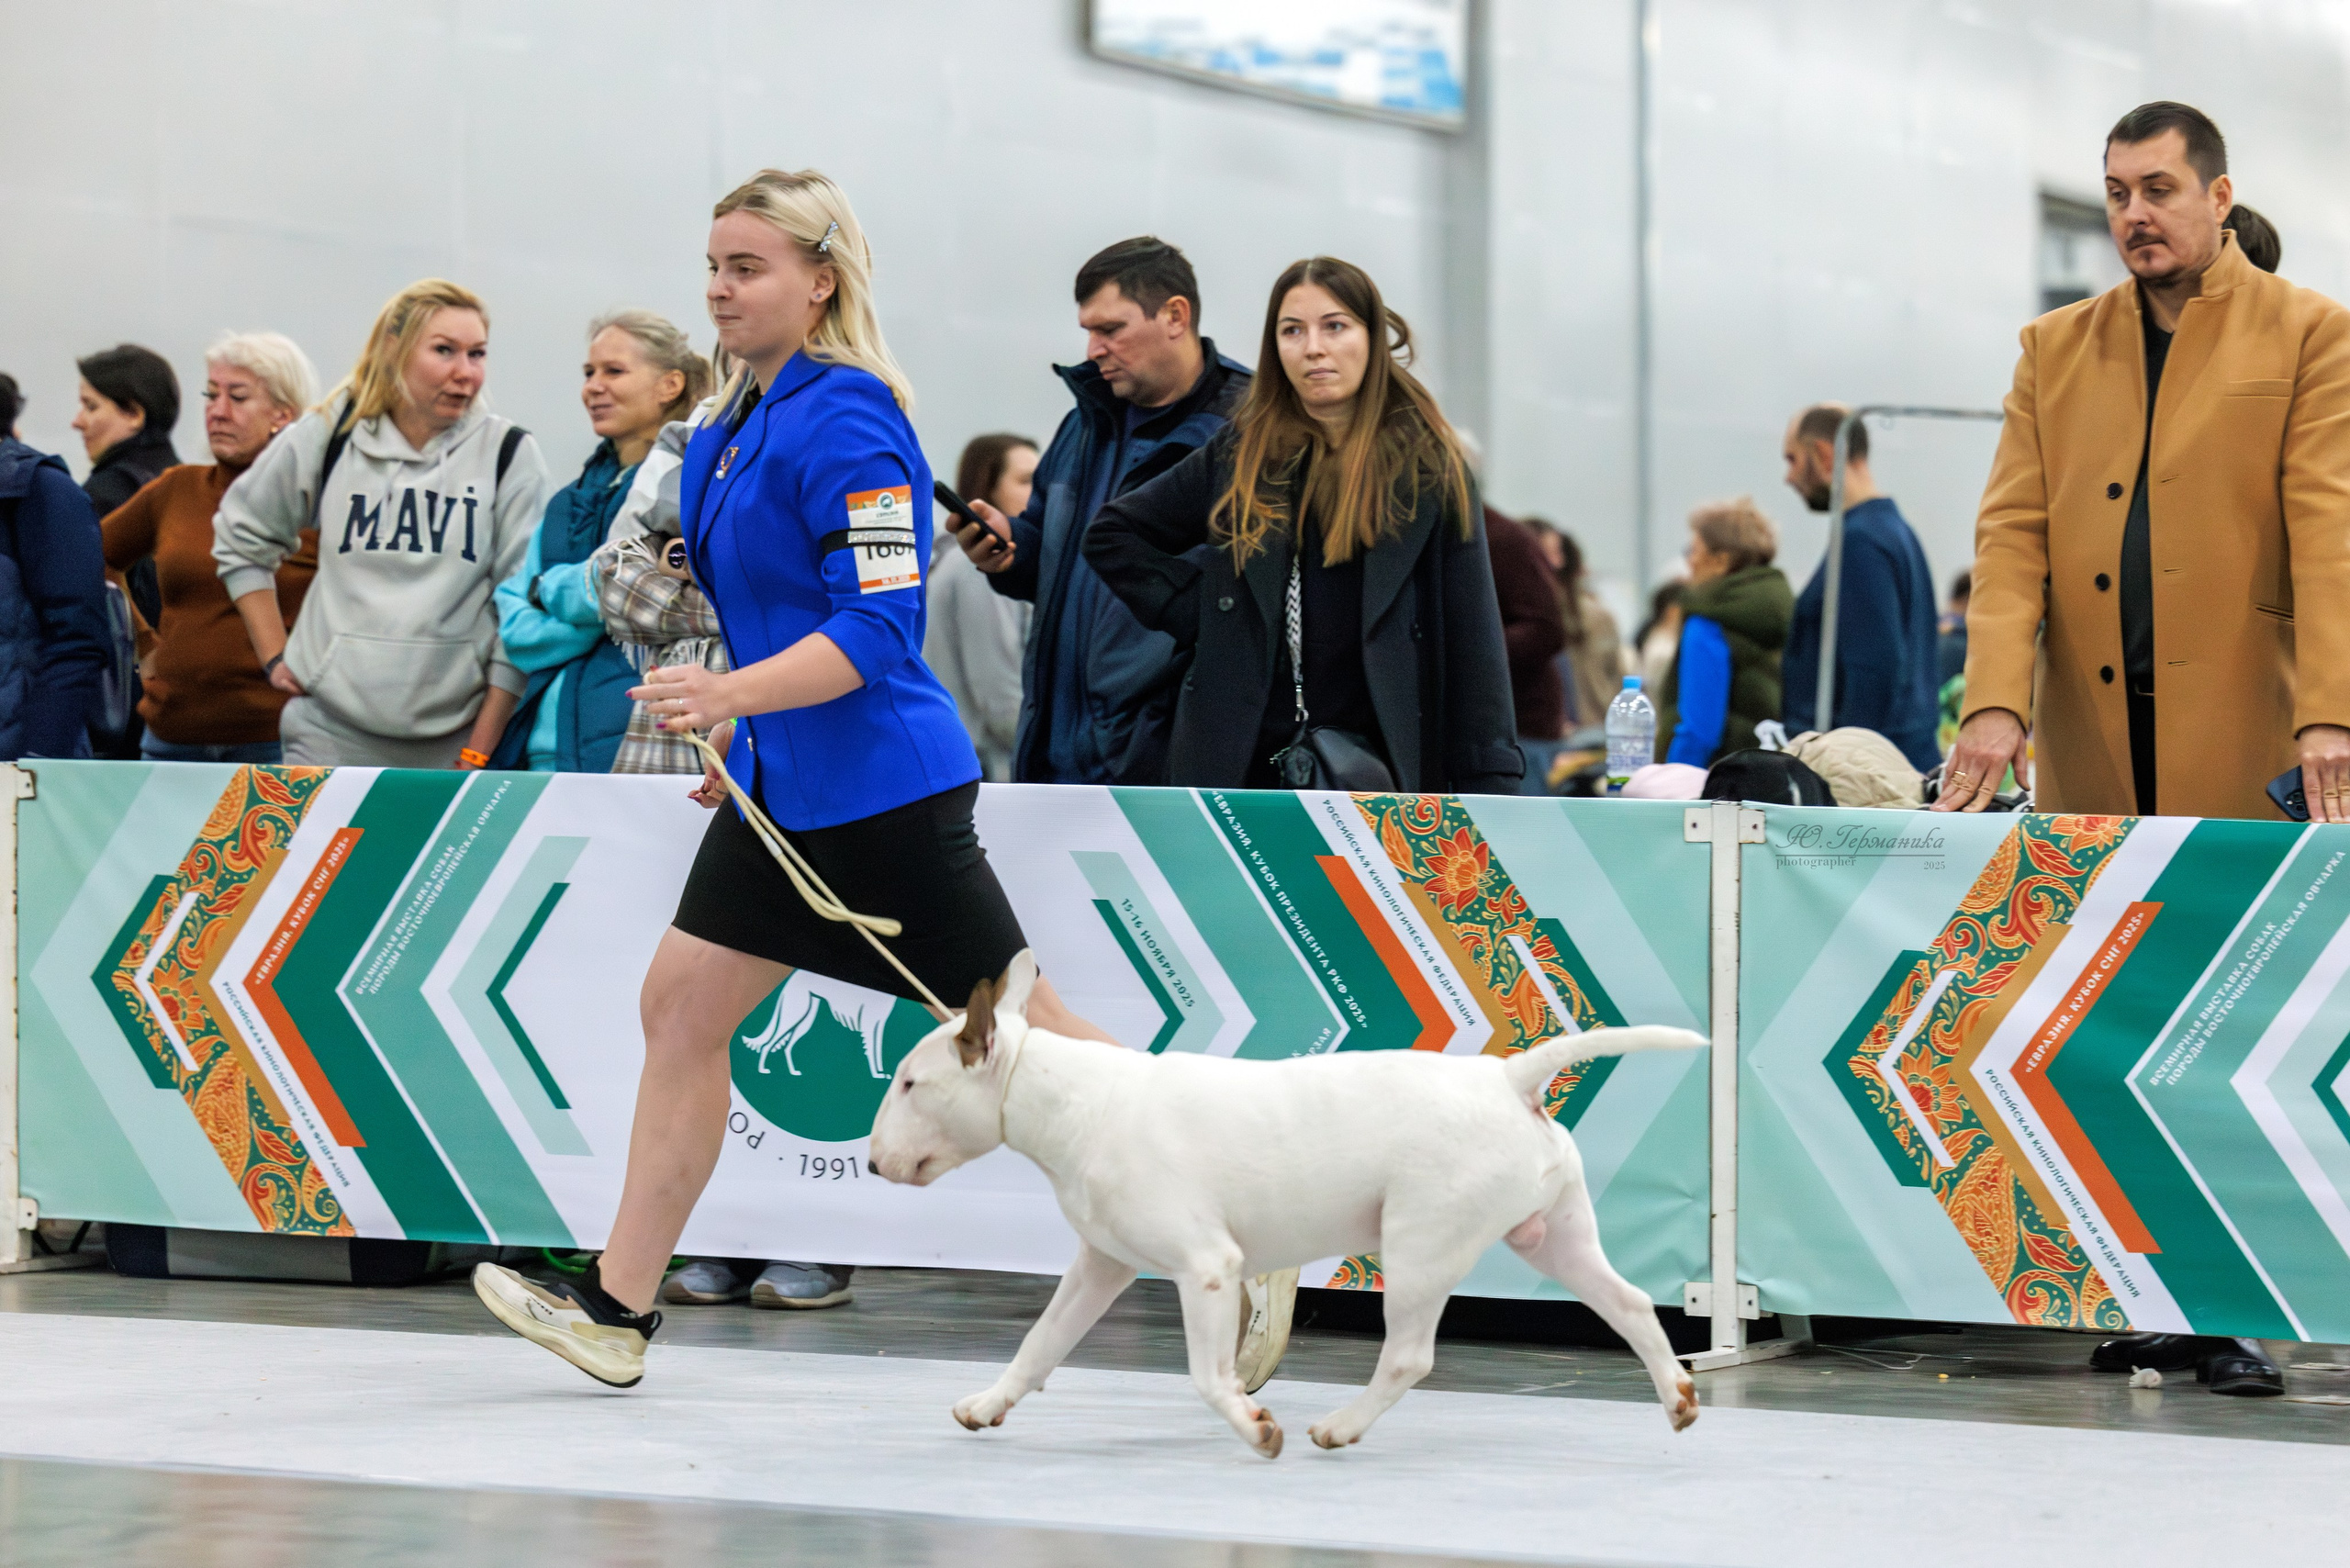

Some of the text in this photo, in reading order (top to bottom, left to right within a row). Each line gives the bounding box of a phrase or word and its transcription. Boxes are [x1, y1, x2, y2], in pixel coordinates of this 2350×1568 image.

[289, 890, 317, 928] КУБОК
[313, 867, 330, 890] СНГ
[355, 845, 455, 994] ВСЕМИРНАЯ ВЫСТАВКА СОБАК
[368, 780, 512, 994] ПОРОДЫ ВОСТОЧНОЕВРОПЕЙСКАЯ ОВЧАРКА
[1122, 899, 1195, 1007] 15-16 НОЯБРЯ 2025
[1249, 850, 1280, 890] КУБОК
[1275, 890, 1330, 969] ПРЕЗИДЕНТА
[1326, 969, 1348, 993] РКФ
[1322, 799, 1476, 1026] РОССИЙСКАЯ КИНОЛОГИЧЕСКАЯ ФЕДЕРАЦИЯ
[2069, 970, 2104, 1012] КУБОК
[2099, 945, 2121, 969] СНГ
[2149, 922, 2277, 1086] ВСЕМИРНАЯ ВЫСТАВКА СОБАК
[2166, 851, 2346, 1085] ПОРОДЫ ВОСТОЧНОЕВРОПЕЙСКАЯ ОВЧАРКА
[222, 980, 351, 1188] РОССИЙСКАЯ КИНОЛОГИЧЕСКАЯ ФЕДЕРАЦИЯ
[800, 1154, 859, 1180] 1991
[1985, 1069, 2141, 1298] РОССИЙСКАЯ КИНОЛОГИЧЕСКАЯ ФЕДЕРАЦИЯ
